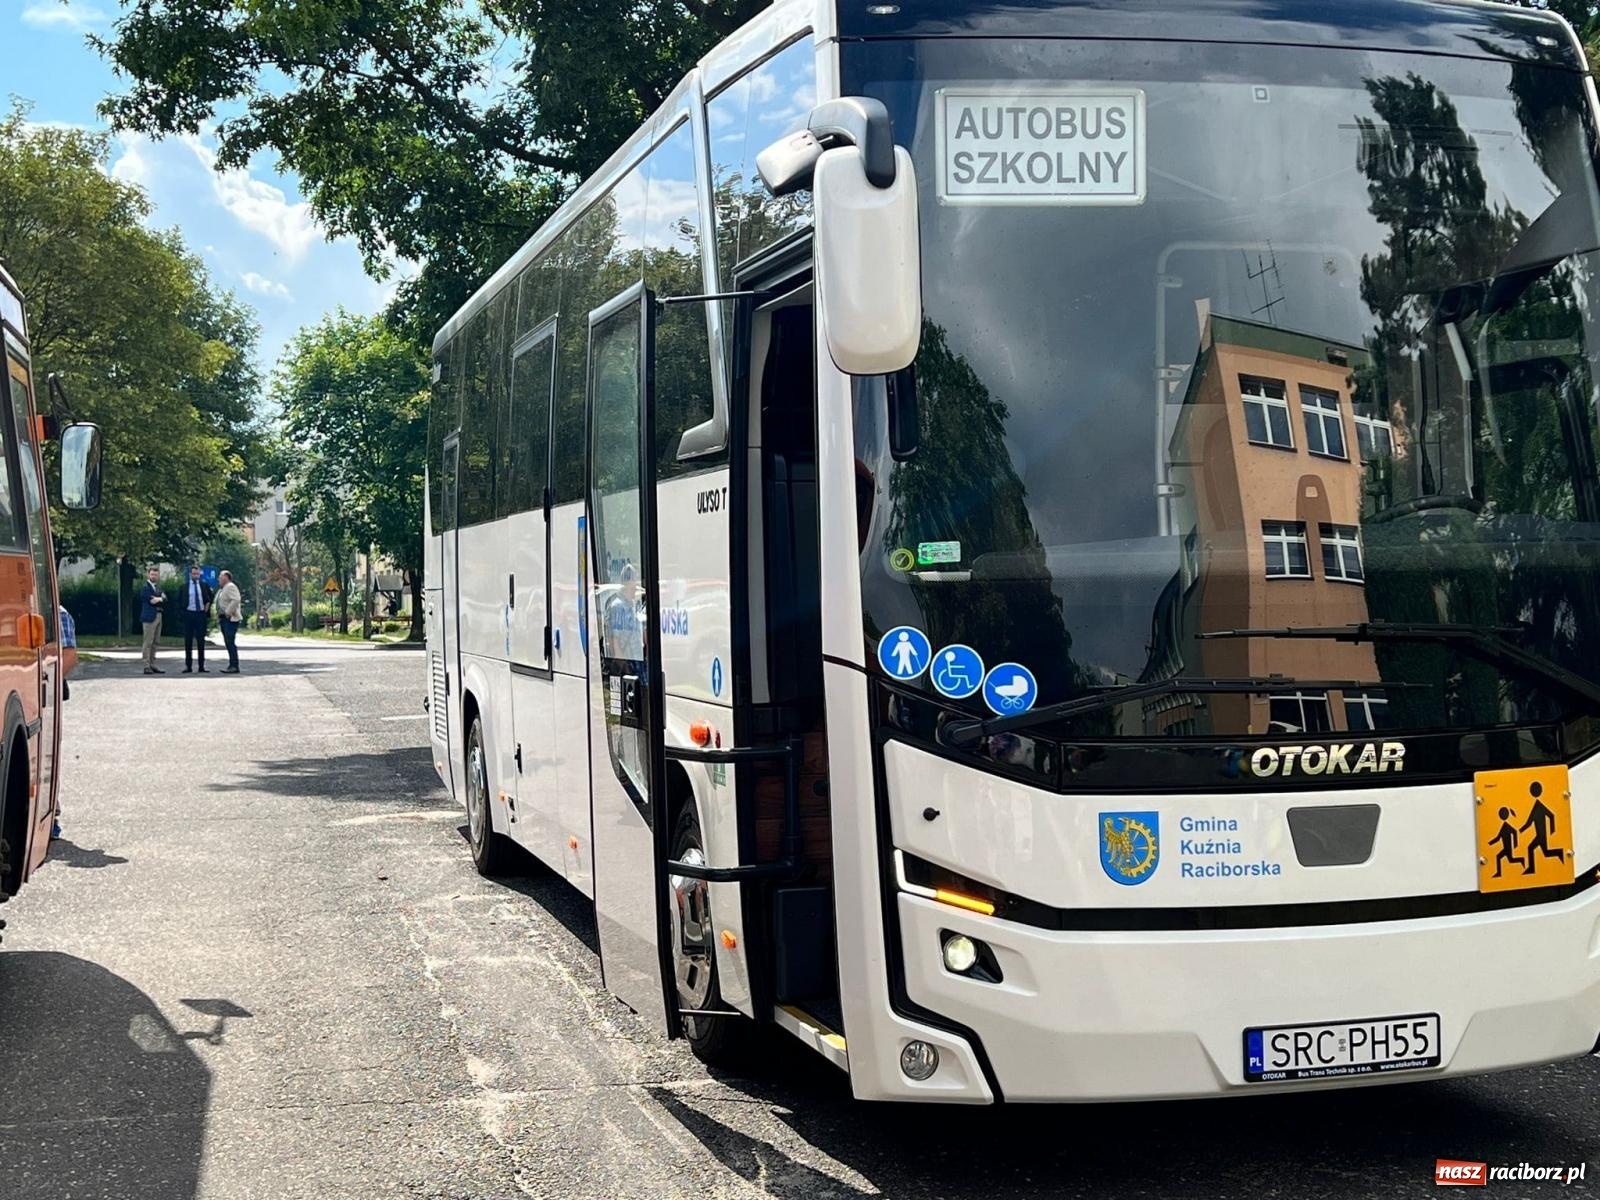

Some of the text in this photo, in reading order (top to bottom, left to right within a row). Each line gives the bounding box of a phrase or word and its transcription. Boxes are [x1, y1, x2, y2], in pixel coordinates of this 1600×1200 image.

[954, 106, 1127, 140] AUTOBUS
[952, 151, 1128, 184] SZKOLNY
[697, 487, 727, 515] ULYSO T
[661, 599, 689, 636] orska
[1251, 742, 1406, 778] OTOKAR
[1180, 816, 1237, 832] Gmina
[1181, 838, 1241, 855] Kuźnia
[1181, 860, 1281, 878] Raciborska
[1271, 1022, 1429, 1067] SRC PH55
[1249, 1057, 1262, 1067] PL
[1262, 1072, 1286, 1080] OTOKAR
